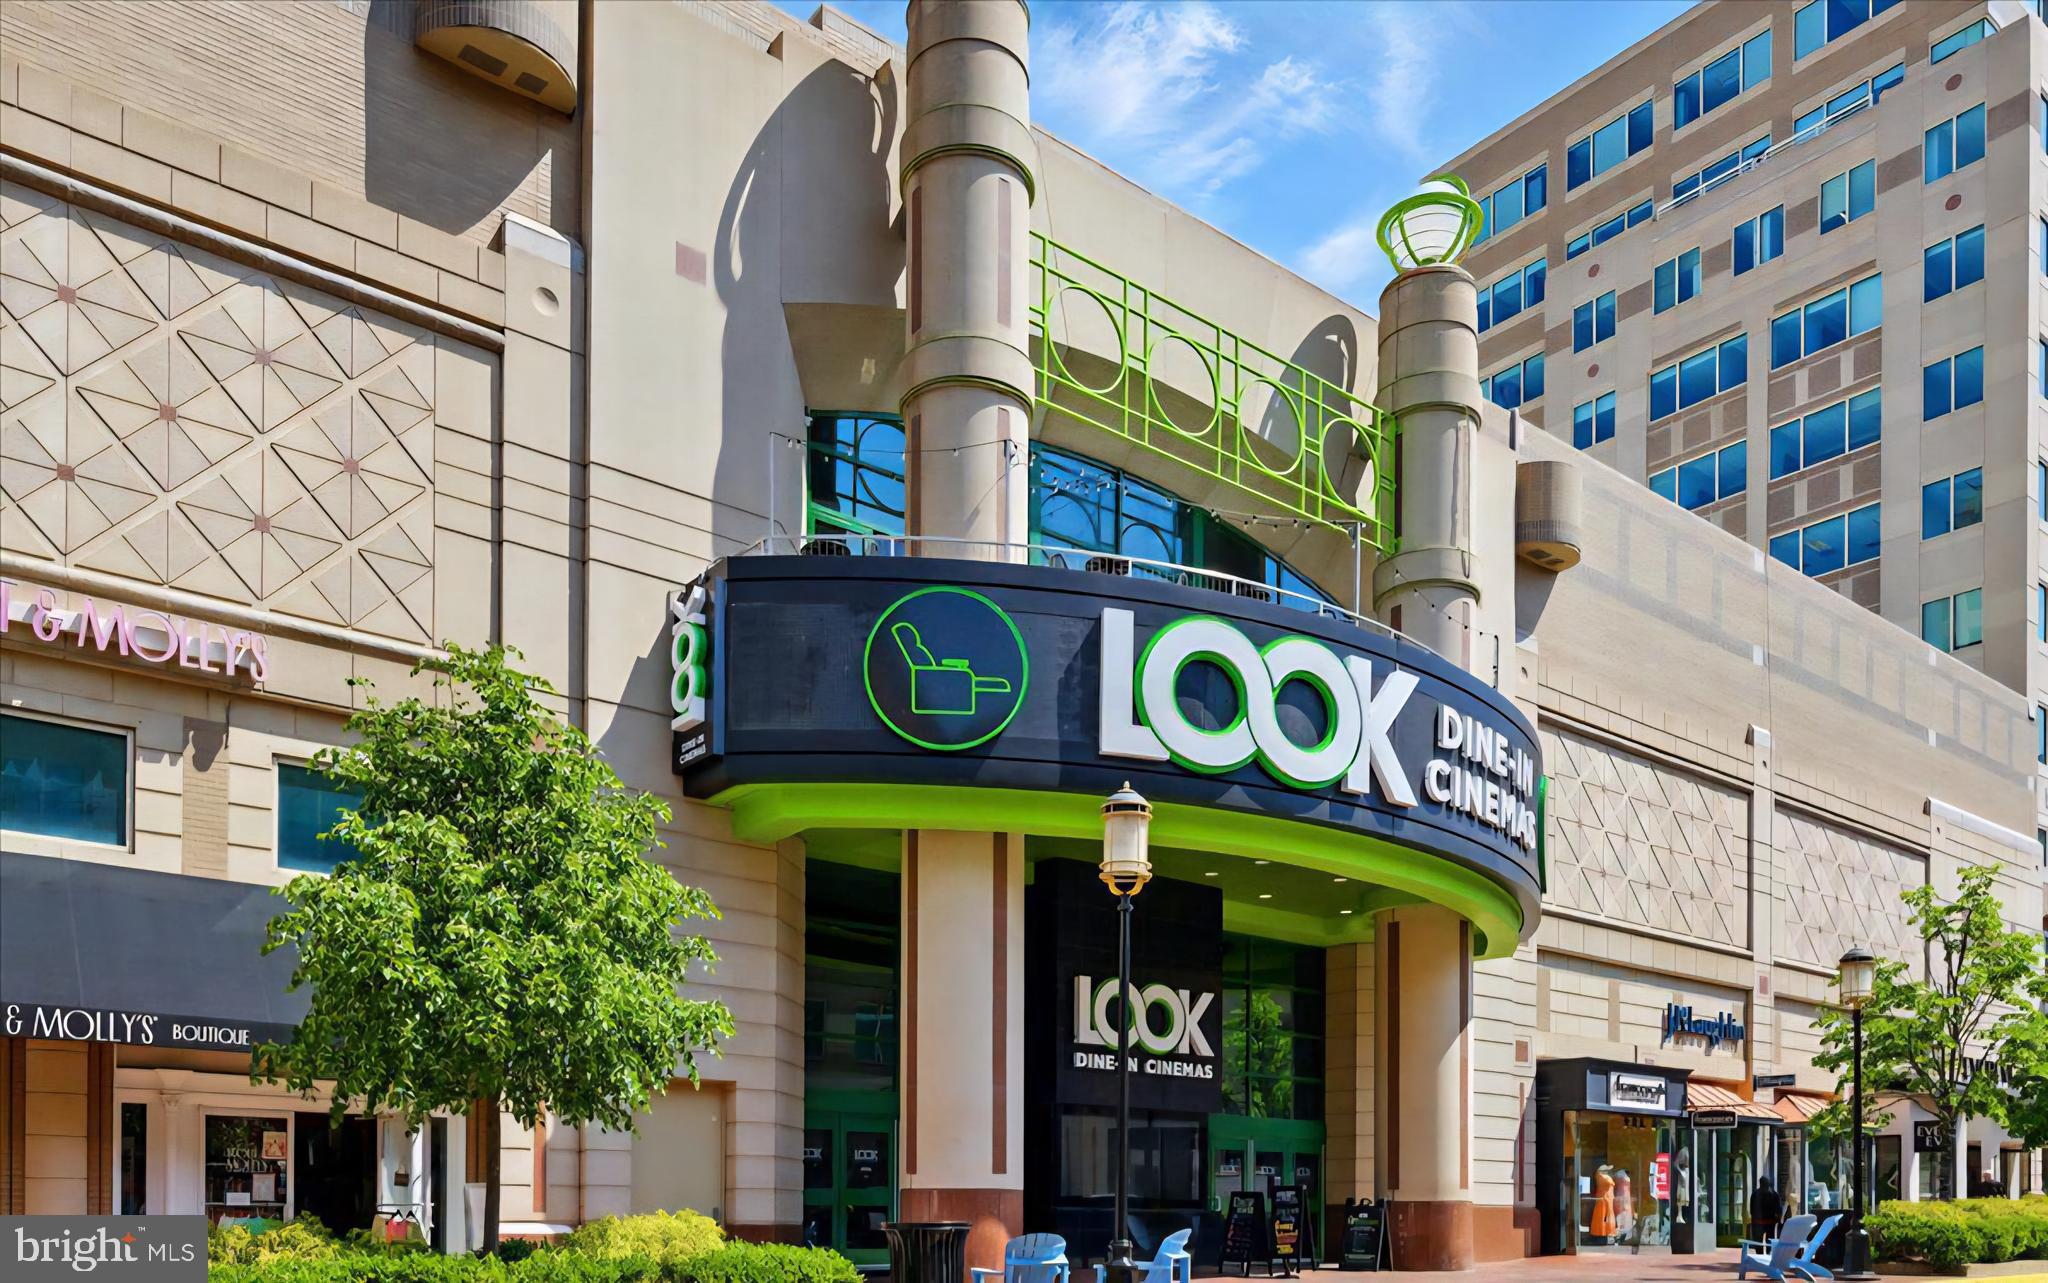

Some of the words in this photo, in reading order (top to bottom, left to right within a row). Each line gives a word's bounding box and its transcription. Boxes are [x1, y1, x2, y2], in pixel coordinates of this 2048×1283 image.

[32, 590, 63, 642] &
[78, 599, 269, 682] MOLLY'S
[671, 584, 707, 733] LOOK
[1099, 607, 1420, 808] LOOK
[1437, 703, 1534, 798] DINE-IN
[1424, 759, 1536, 850] CINEMAS
[6, 1005, 23, 1035] &
[33, 1006, 155, 1045] MOLLY'S
[172, 1024, 250, 1046] BOUTIQUE
[1074, 975, 1215, 1056] LOOK
[1074, 1052, 1138, 1072] DINE-N
[1144, 1059, 1214, 1079] CINEMAS
